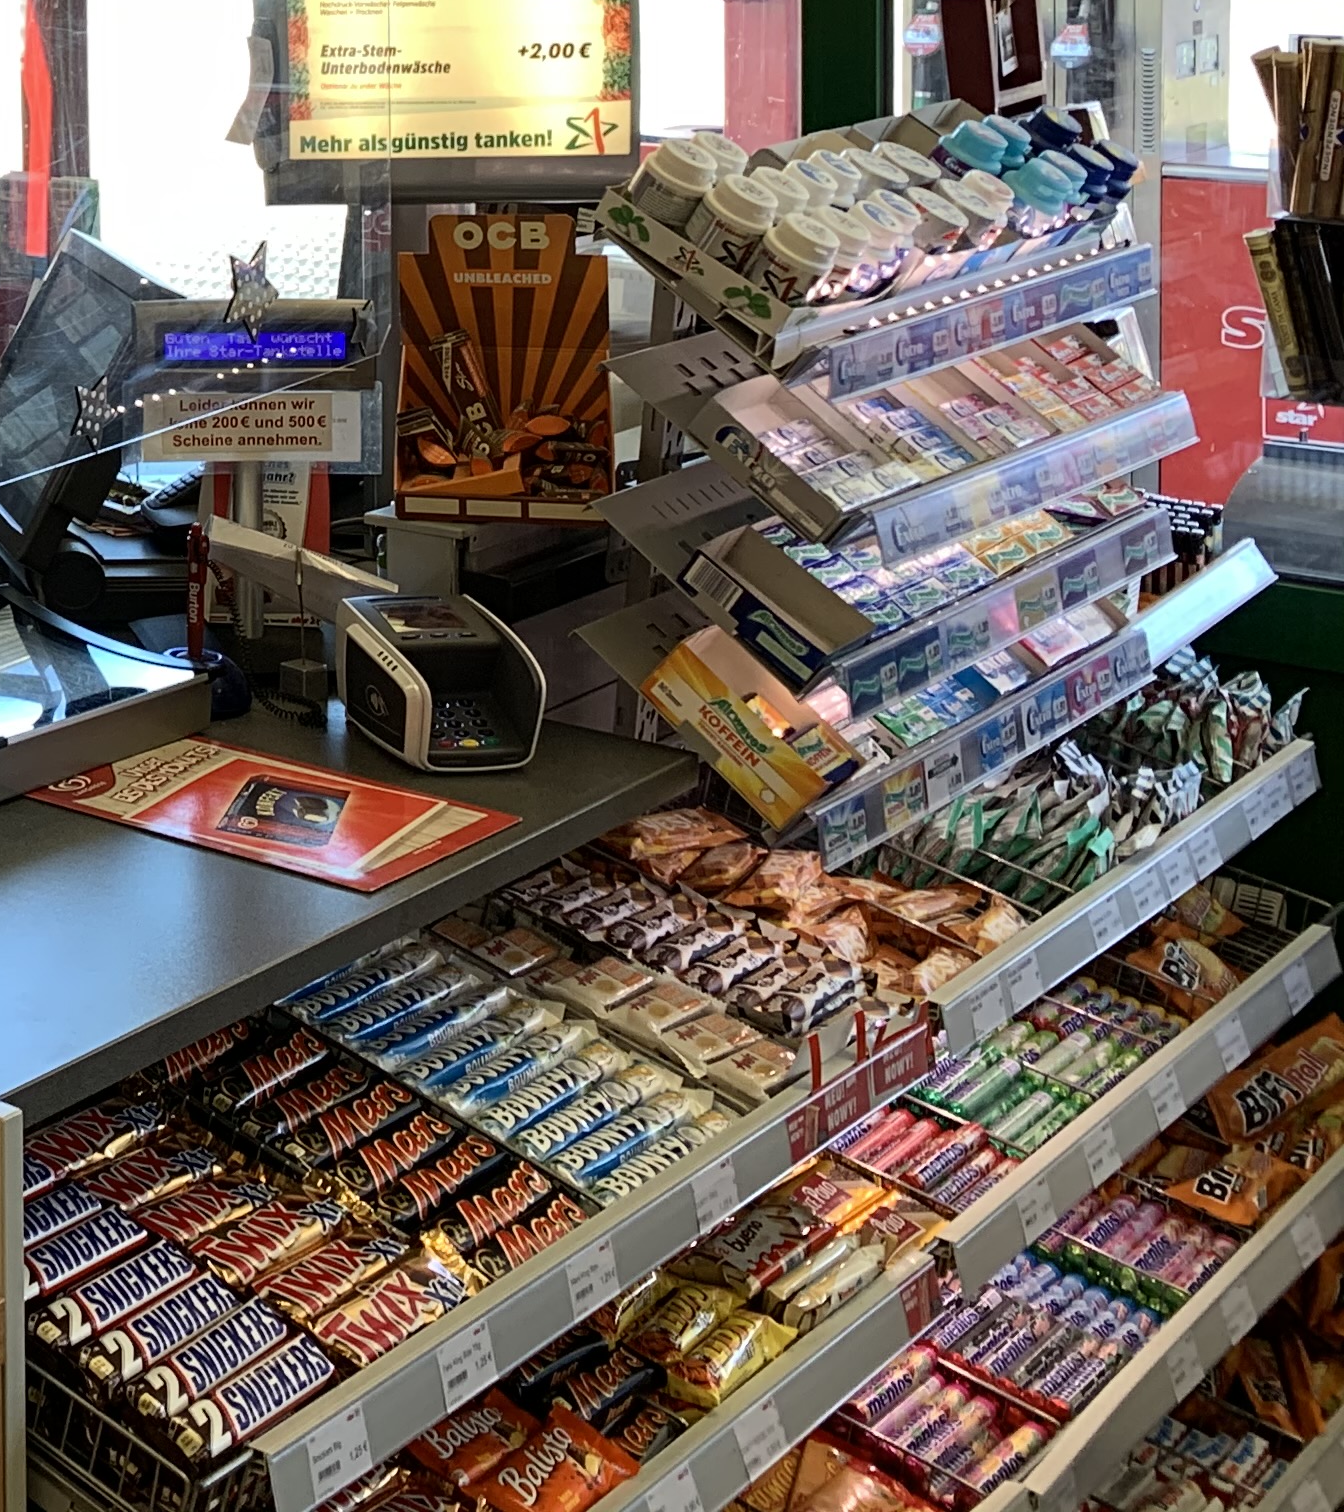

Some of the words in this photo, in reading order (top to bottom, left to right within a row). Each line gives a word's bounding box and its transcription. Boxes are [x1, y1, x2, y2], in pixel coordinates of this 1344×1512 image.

[517, 43, 575, 61] +2,00
[579, 42, 592, 58] €
[321, 61, 451, 75] Unterbodenwäsche
[299, 136, 351, 153] Mehr
[359, 134, 387, 152] als
[391, 131, 468, 153] günstig
[475, 129, 552, 149] tanken!
[1321, 94, 1340, 178] INDEPENDENCE
[453, 220, 551, 250] OCB
[453, 272, 552, 286] UNBLEACHED
[165, 333, 210, 344] Guten
[270, 333, 332, 344] wünscht
[166, 346, 202, 357] Ihre
[291, 398, 315, 410] wir
[169, 416, 207, 429] kne
[255, 416, 283, 428] und
[173, 435, 232, 447] Scheine
[238, 434, 322, 446] annehmen.
[699, 705, 761, 767] KOFFEIN
[488, 1073, 575, 1128] BOUNTY
[318, 1080, 413, 1160] Mars
[919, 1142, 967, 1186] mentos
[734, 1218, 764, 1264] bueno
[87, 1243, 194, 1323] SNICKERS
[222, 1339, 333, 1431] SNICKERS
